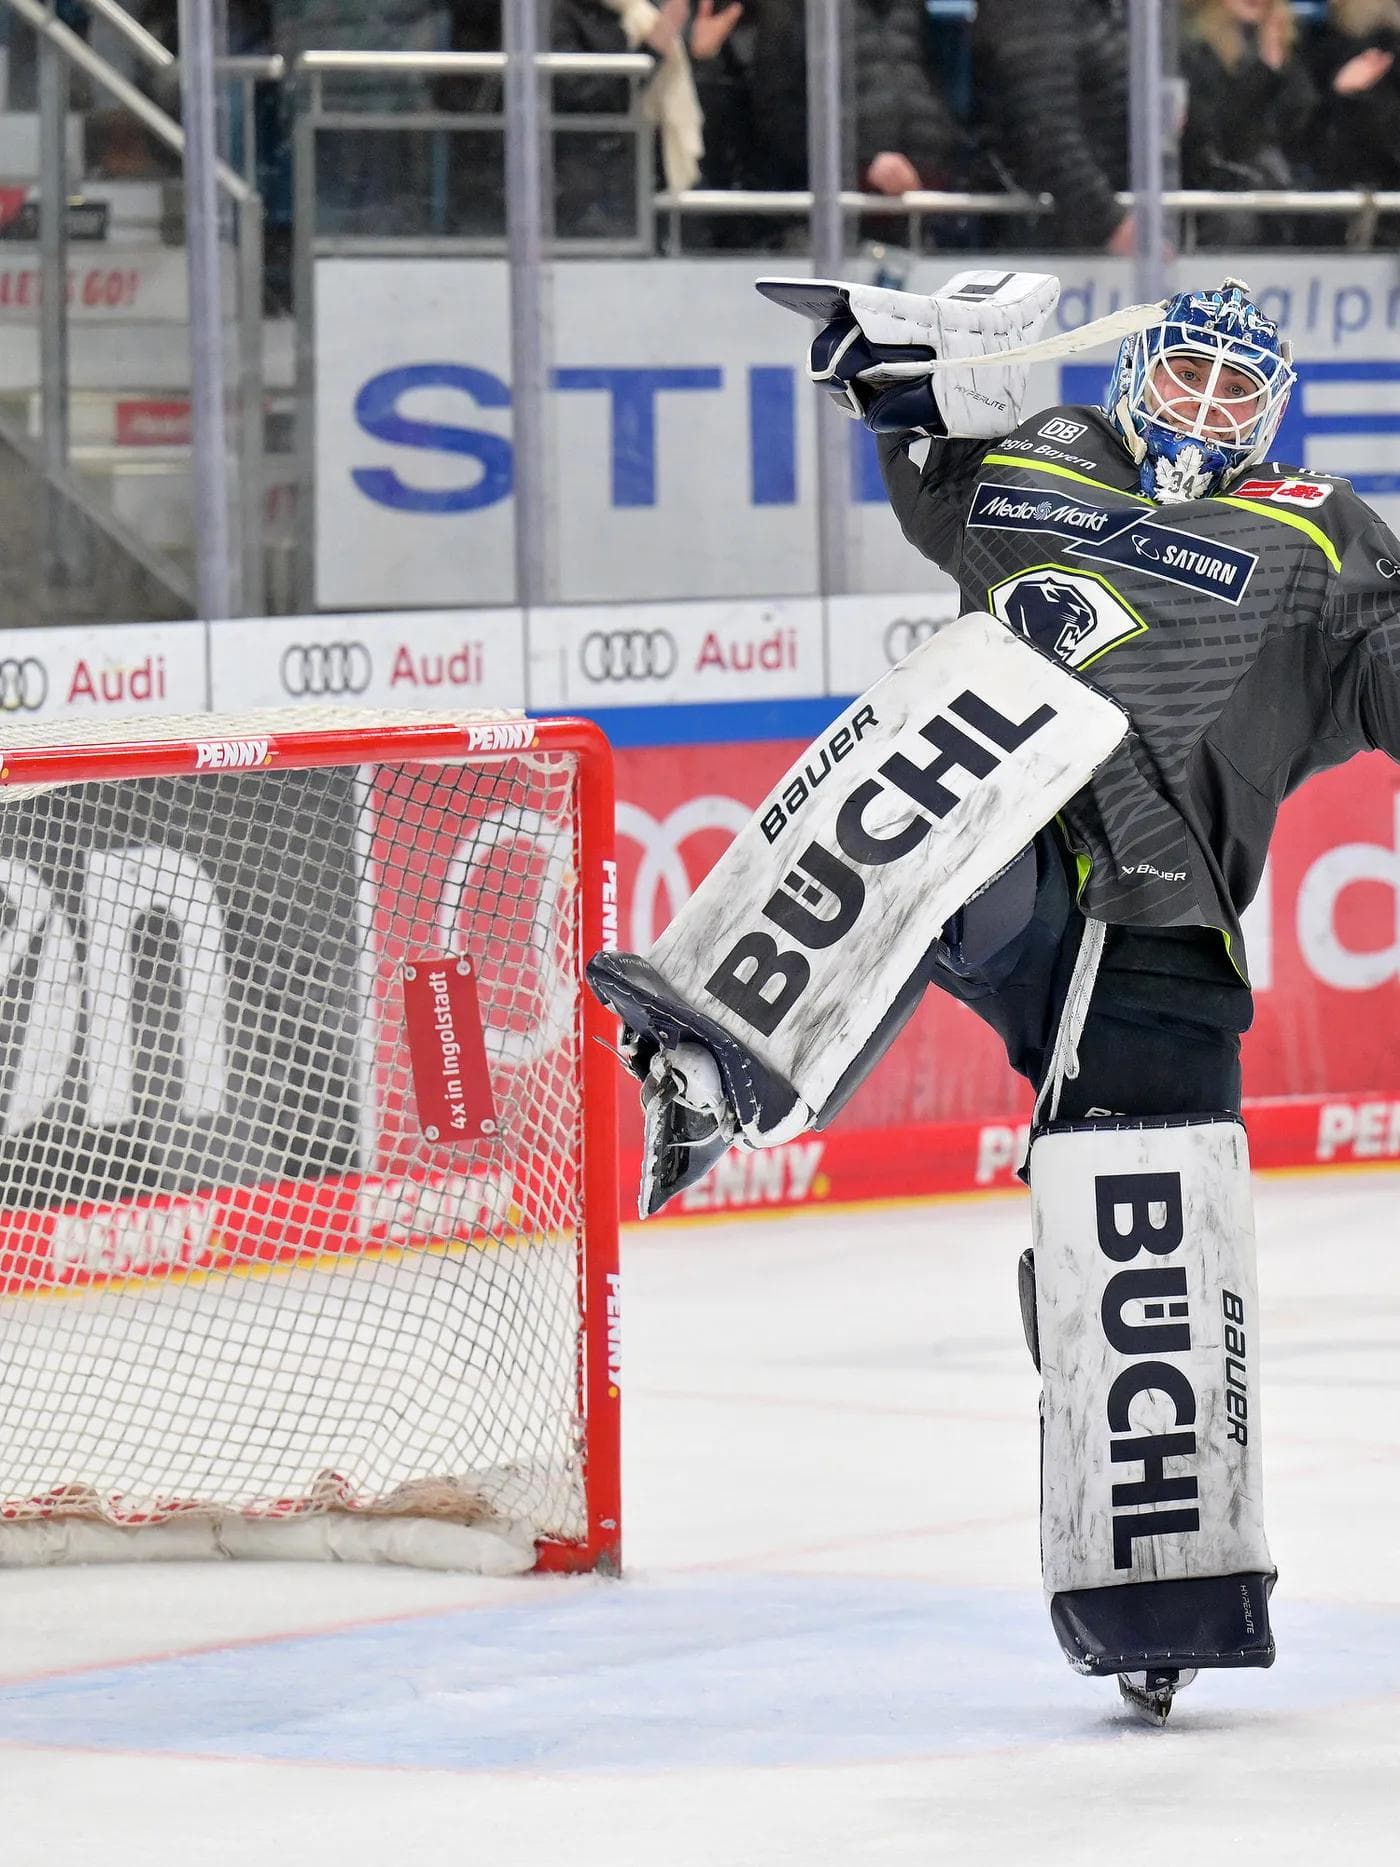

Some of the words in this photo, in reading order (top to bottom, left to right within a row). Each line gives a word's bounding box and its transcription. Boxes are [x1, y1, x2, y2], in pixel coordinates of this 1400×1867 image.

[1047, 420, 1080, 440] DB
[999, 437, 1033, 453] egio
[1034, 445, 1097, 470] Bayern
[1168, 470, 1195, 499] 34
[1162, 545, 1238, 586] SATURN
[389, 641, 484, 689] Audi
[695, 630, 799, 674] Audi
[66, 658, 165, 703] Audi
[760, 703, 881, 845] BAUER
[704, 689, 1058, 1038] BÜCHL
[1136, 864, 1187, 881] BAUER
[602, 860, 618, 952] PENN
[428, 971, 461, 1076] Ingolstadt
[444, 1079, 463, 1100] in
[450, 1102, 467, 1130] 4x
[1094, 1171, 1201, 1570] BÜCHL
[1221, 1289, 1248, 1447] BAUER
